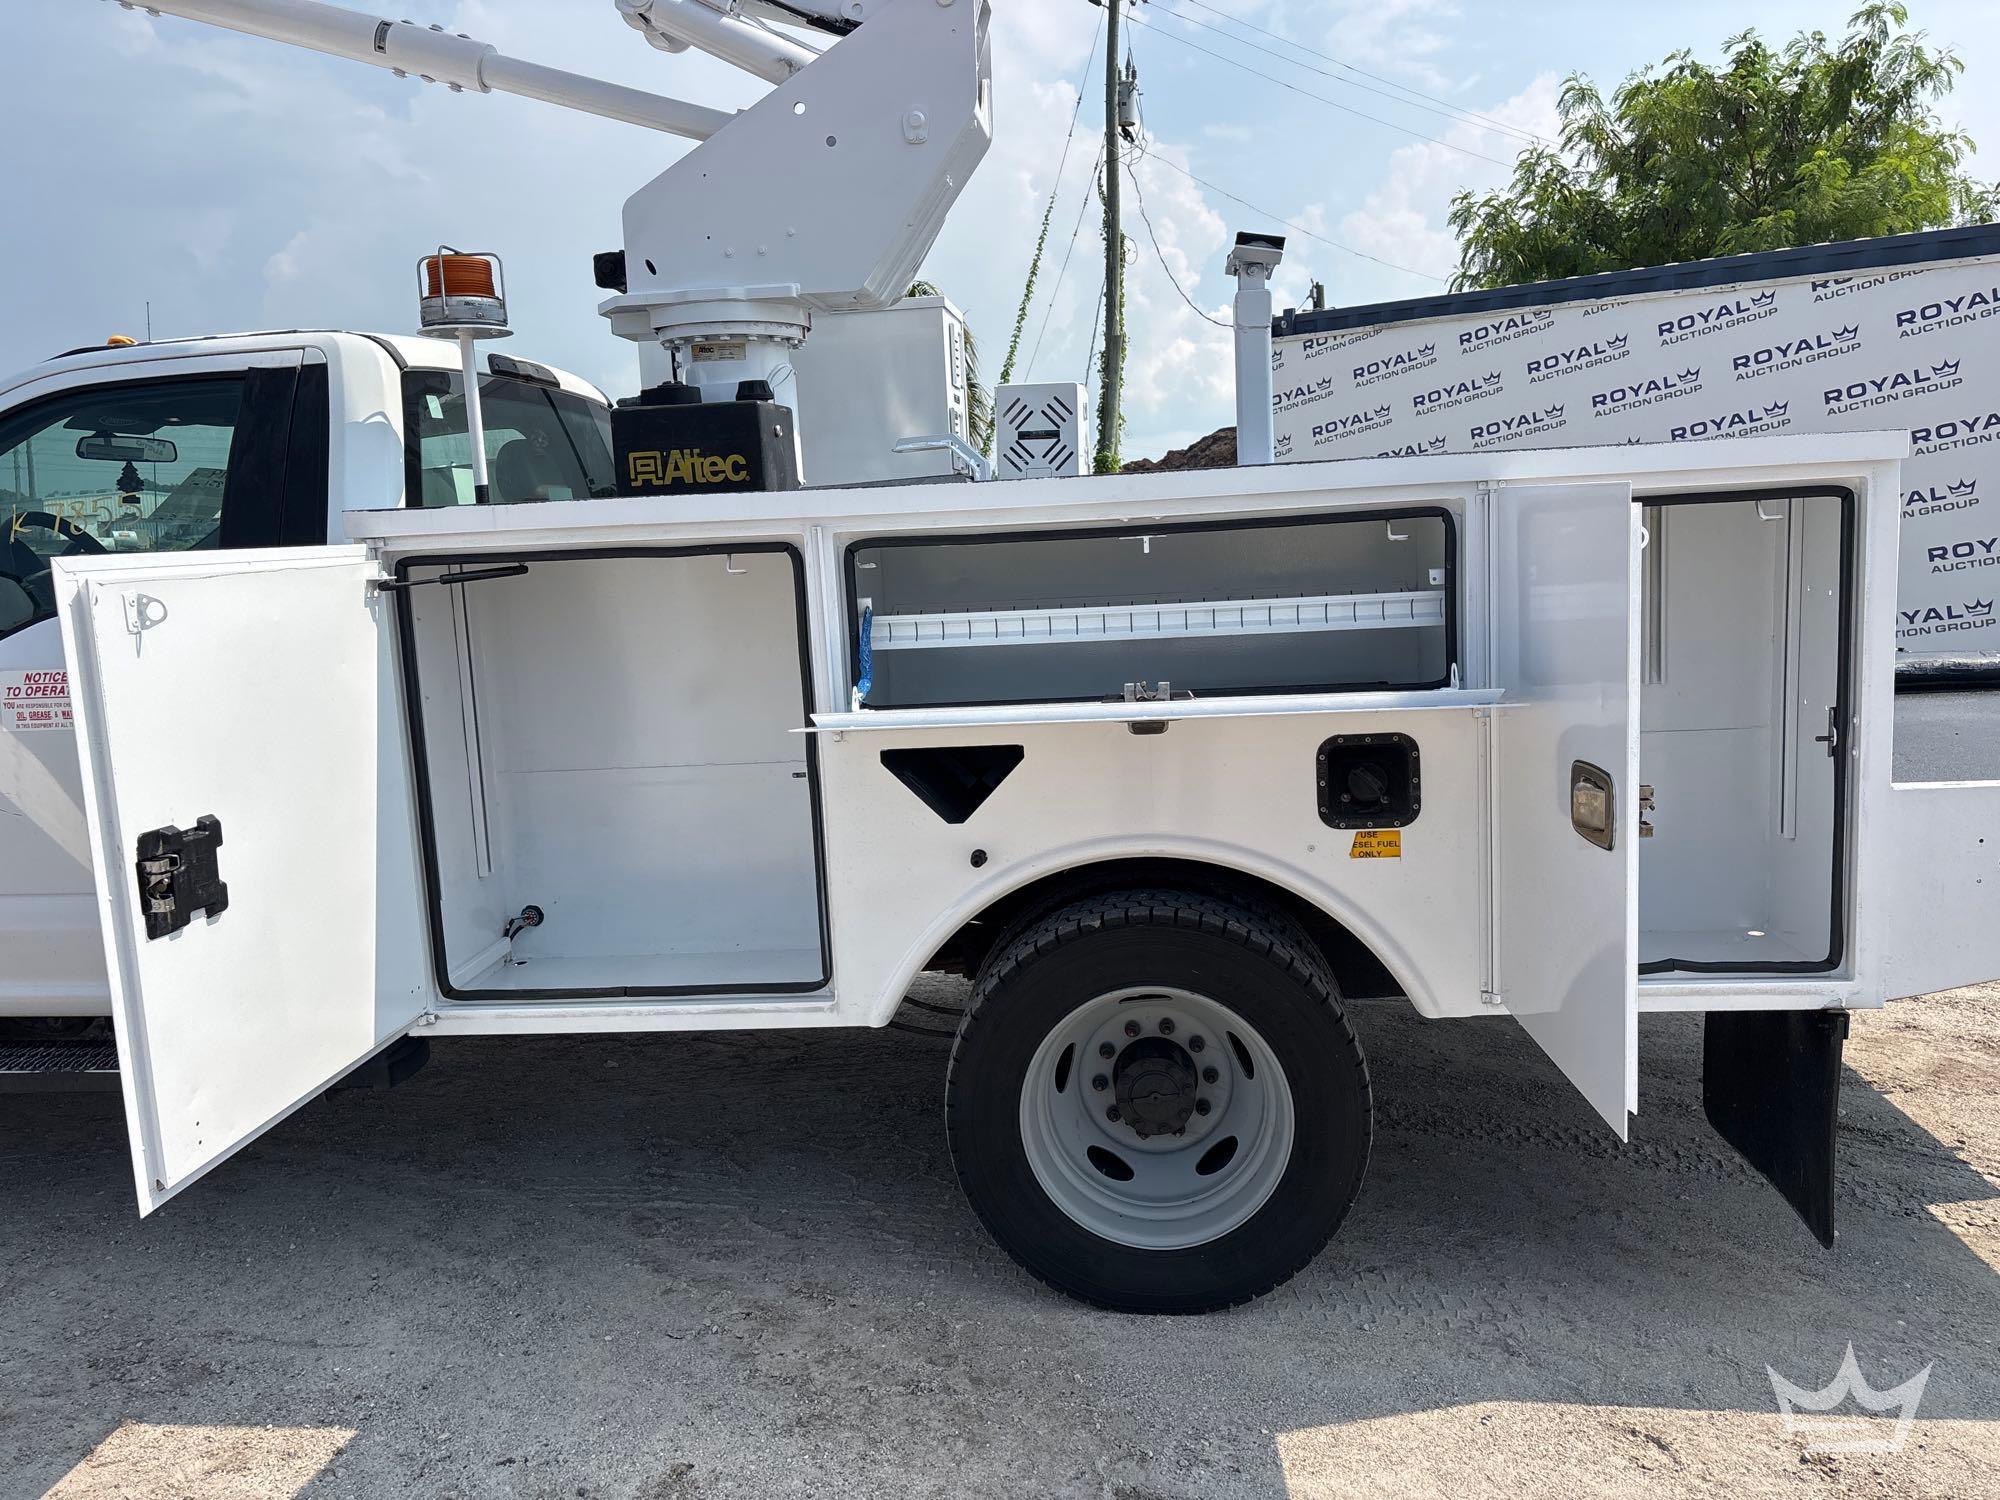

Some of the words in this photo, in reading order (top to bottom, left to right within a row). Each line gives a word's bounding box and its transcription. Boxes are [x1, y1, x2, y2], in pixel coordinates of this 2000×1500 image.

[1813, 276, 1885, 303] AUCTION
[1459, 314, 1532, 346] ROYAL
[1658, 300, 1750, 337] ROYAL
[1661, 323, 1723, 347] AUCTION
[1726, 307, 1778, 328] GROUP
[1899, 313, 1976, 339] AUCTION
[1305, 341, 1346, 360] AUCTION
[1348, 329, 1383, 345] GROUP
[1461, 334, 1511, 356] AUCTION
[1513, 320, 1555, 338] GROUP
[1733, 334, 1832, 371] ROYAL
[1353, 351, 1418, 380] ROYAL
[1355, 369, 1399, 388] AUCTION
[1401, 357, 1438, 374] GROUP
[1527, 343, 1607, 374] ROYAL
[1529, 363, 1583, 385] AUCTION
[1586, 350, 1630, 369] GROUP
[1735, 352, 1803, 382] AUCTION
[1805, 342, 1862, 364] GROUP
[1273, 384, 1317, 406] OYAL
[1413, 379, 1482, 408] ROYAL
[1415, 398, 1462, 417] AUCTION
[1464, 386, 1504, 403] GROUP
[1592, 376, 1676, 408] ROYAL
[1594, 397, 1652, 418] AUCTION
[1655, 384, 1703, 402] GROUP
[1824, 369, 1931, 405] ROYAL
[1826, 392, 1899, 416] AUCTION
[1902, 378, 1963, 399] GROUP
[1273, 401, 1299, 415] CTION
[1301, 391, 1334, 406] GROUP
[1312, 411, 1374, 438] ROYAL
[1314, 429, 1356, 447] AUCTION
[1358, 418, 1393, 434] GROUP
[1470, 412, 1544, 440] ROYAL
[1473, 430, 1522, 449] AUCTION
[1525, 419, 1567, 436] GROUP
[1671, 409, 1763, 440] ROYAL
[1738, 418, 1791, 437] GROUP
[1911, 413, 2000, 445] ROYA
[1914, 433, 1992, 456] AUCTION
[664, 449, 747, 485] Altec
[1918, 497, 1979, 516] GROUP
[1927, 537, 2000, 562] ROY
[1935, 618, 1996, 633] GROUP
[6, 687, 21, 697] TO
[24, 672, 68, 683] NOTICE
[1360, 831, 1378, 839] USE
